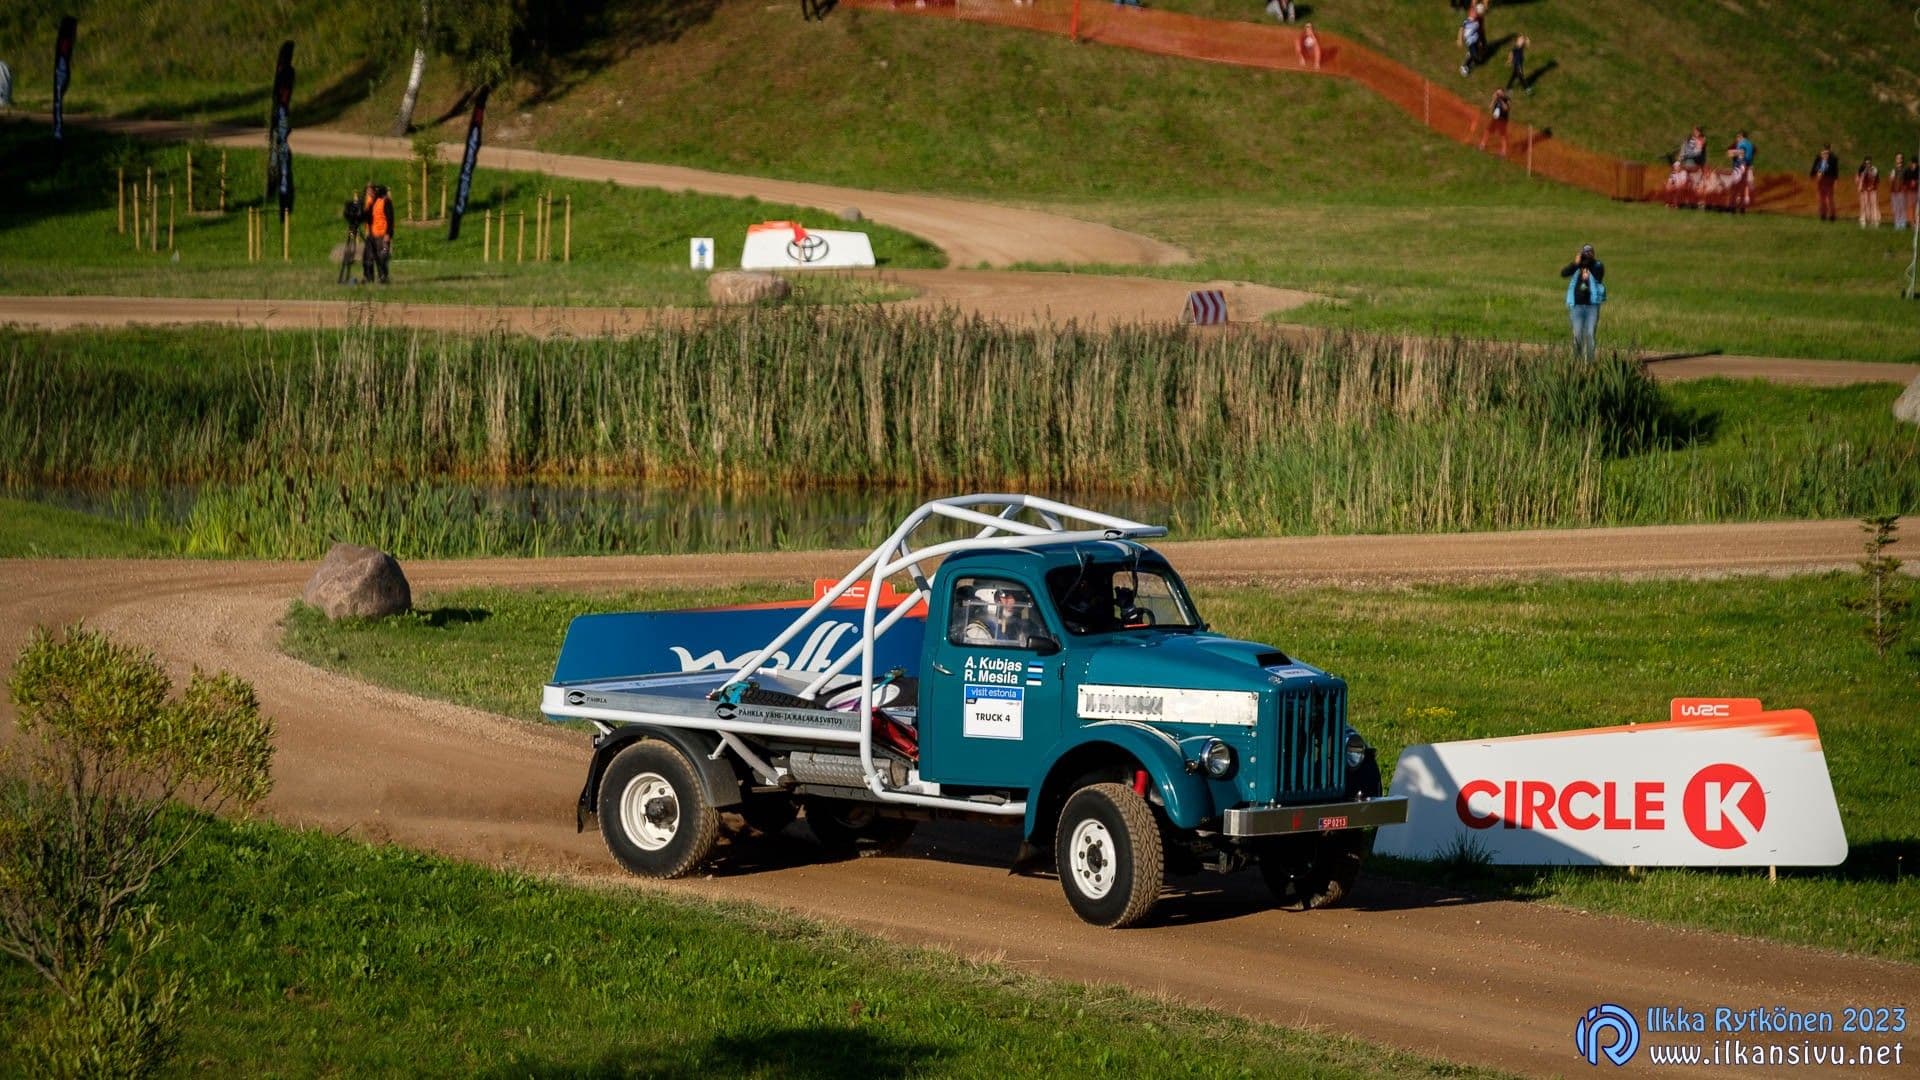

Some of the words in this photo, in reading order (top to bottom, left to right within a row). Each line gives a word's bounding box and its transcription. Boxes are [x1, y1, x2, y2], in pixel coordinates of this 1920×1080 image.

[964, 655, 977, 668] A.
[979, 656, 1022, 673] Kubjas
[964, 669, 976, 682] R.
[978, 670, 1018, 684] Mesila
[971, 688, 988, 696] visit
[988, 689, 1017, 698] estonia
[1681, 704, 1729, 716] WRC
[975, 712, 1003, 722] TRUCK
[1005, 714, 1011, 722] 4
[1455, 779, 1665, 830] CIRCLE
[1702, 778, 1762, 845] K
